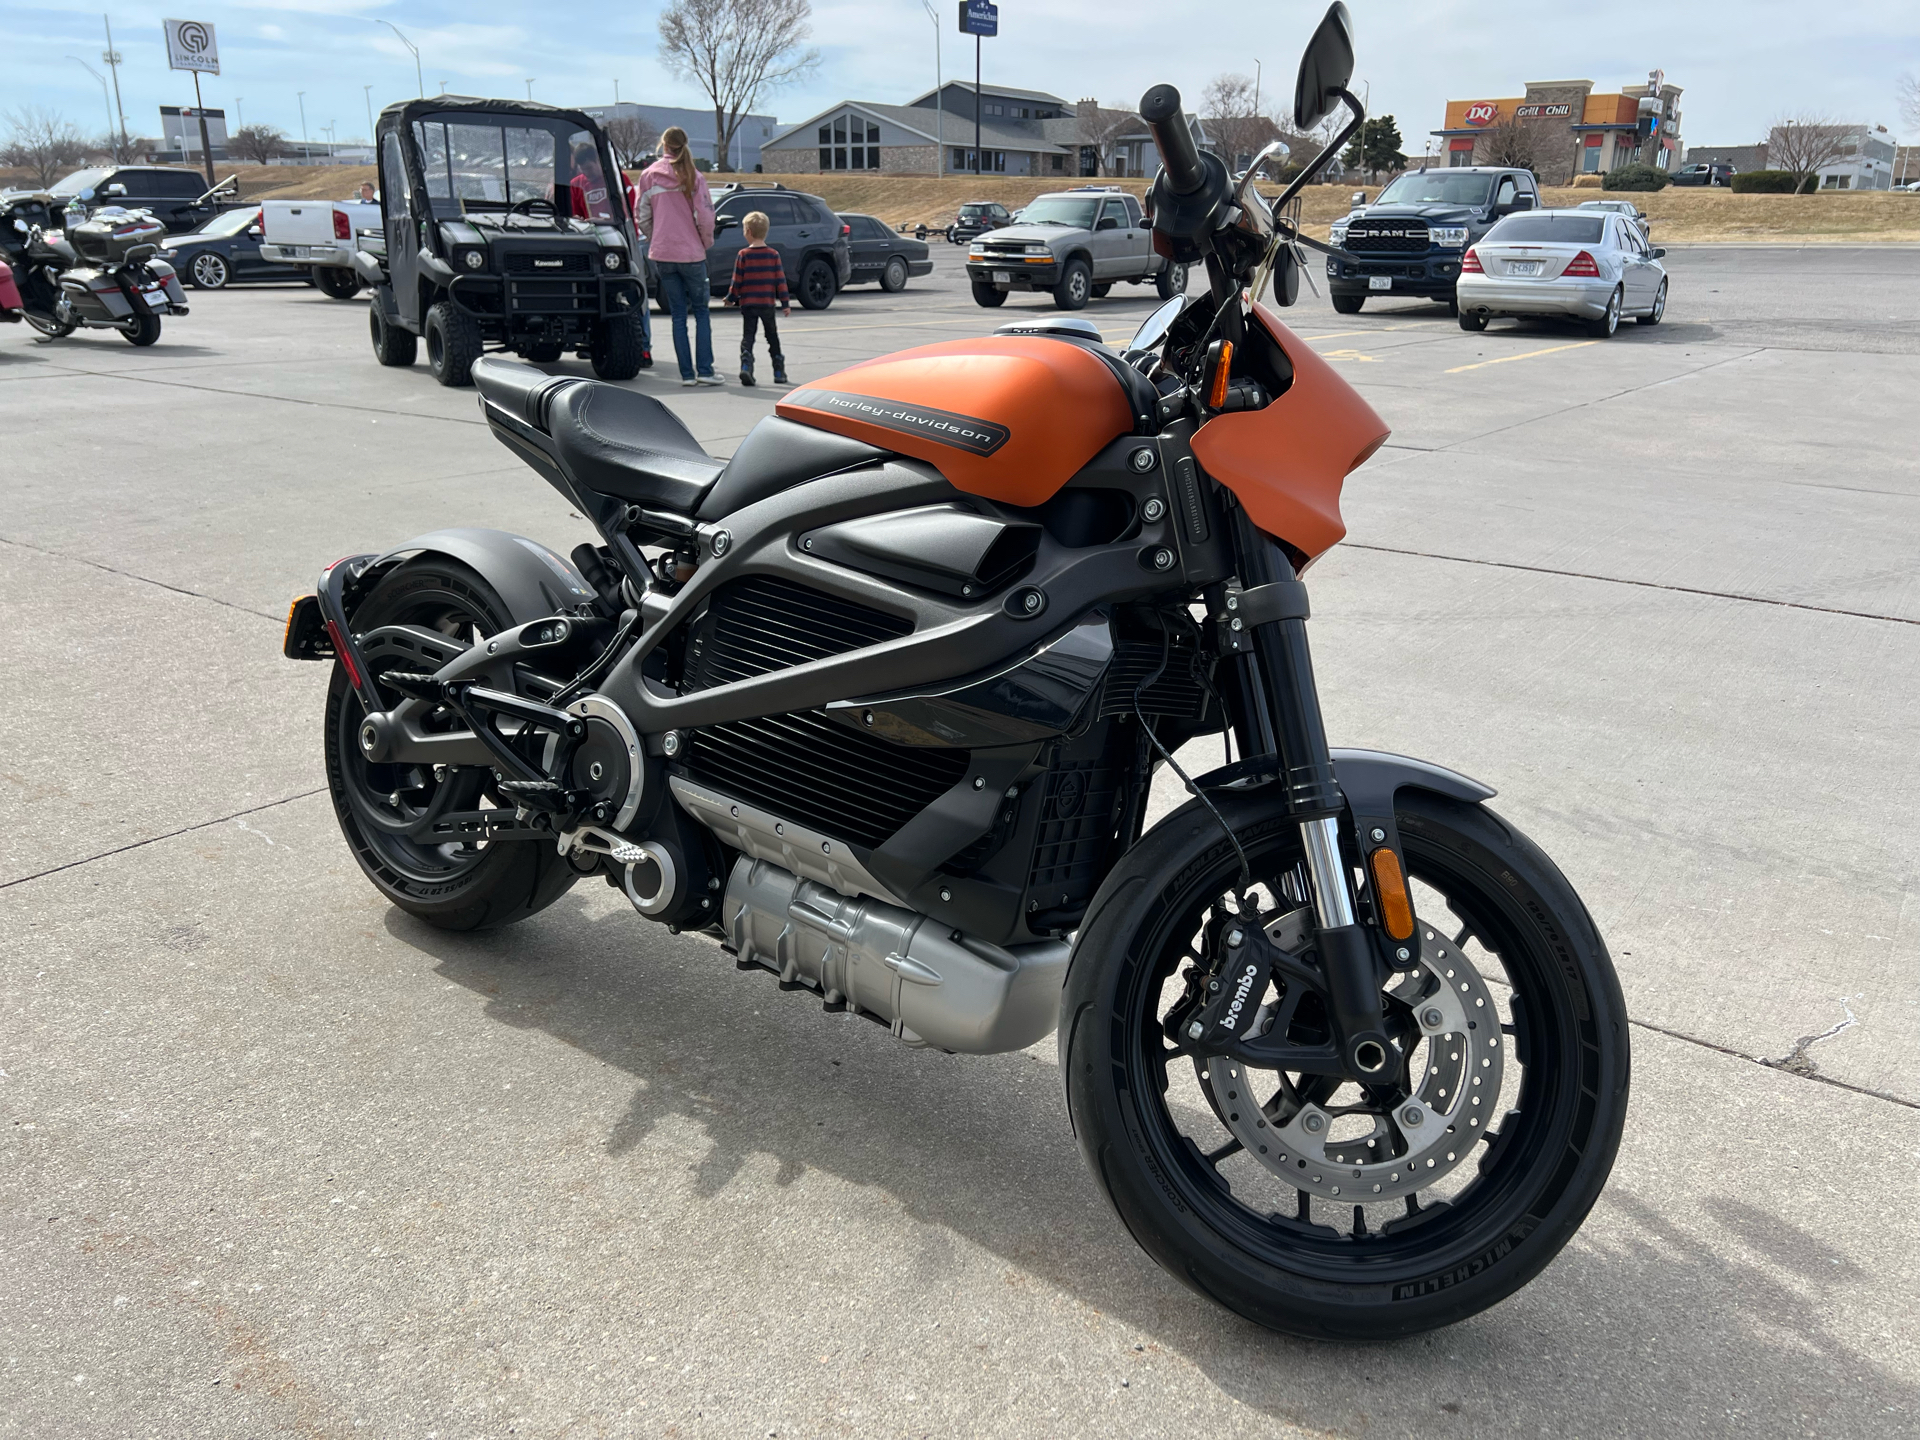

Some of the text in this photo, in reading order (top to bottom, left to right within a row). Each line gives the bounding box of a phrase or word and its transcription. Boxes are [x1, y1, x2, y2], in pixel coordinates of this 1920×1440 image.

[175, 54, 219, 64] LINCOLN
[1468, 106, 1493, 121] DQ
[1517, 106, 1538, 117] Grill
[1545, 104, 1570, 115] Chill
[828, 396, 992, 443] harley-davidson
[329, 699, 343, 791] MICHELIN
[1526, 900, 1578, 981] 120/70 ZR 17
[1219, 964, 1257, 1030] brembo
[1144, 1155, 1188, 1213] SCORCHER
[1400, 1240, 1512, 1299] MICHELIN
